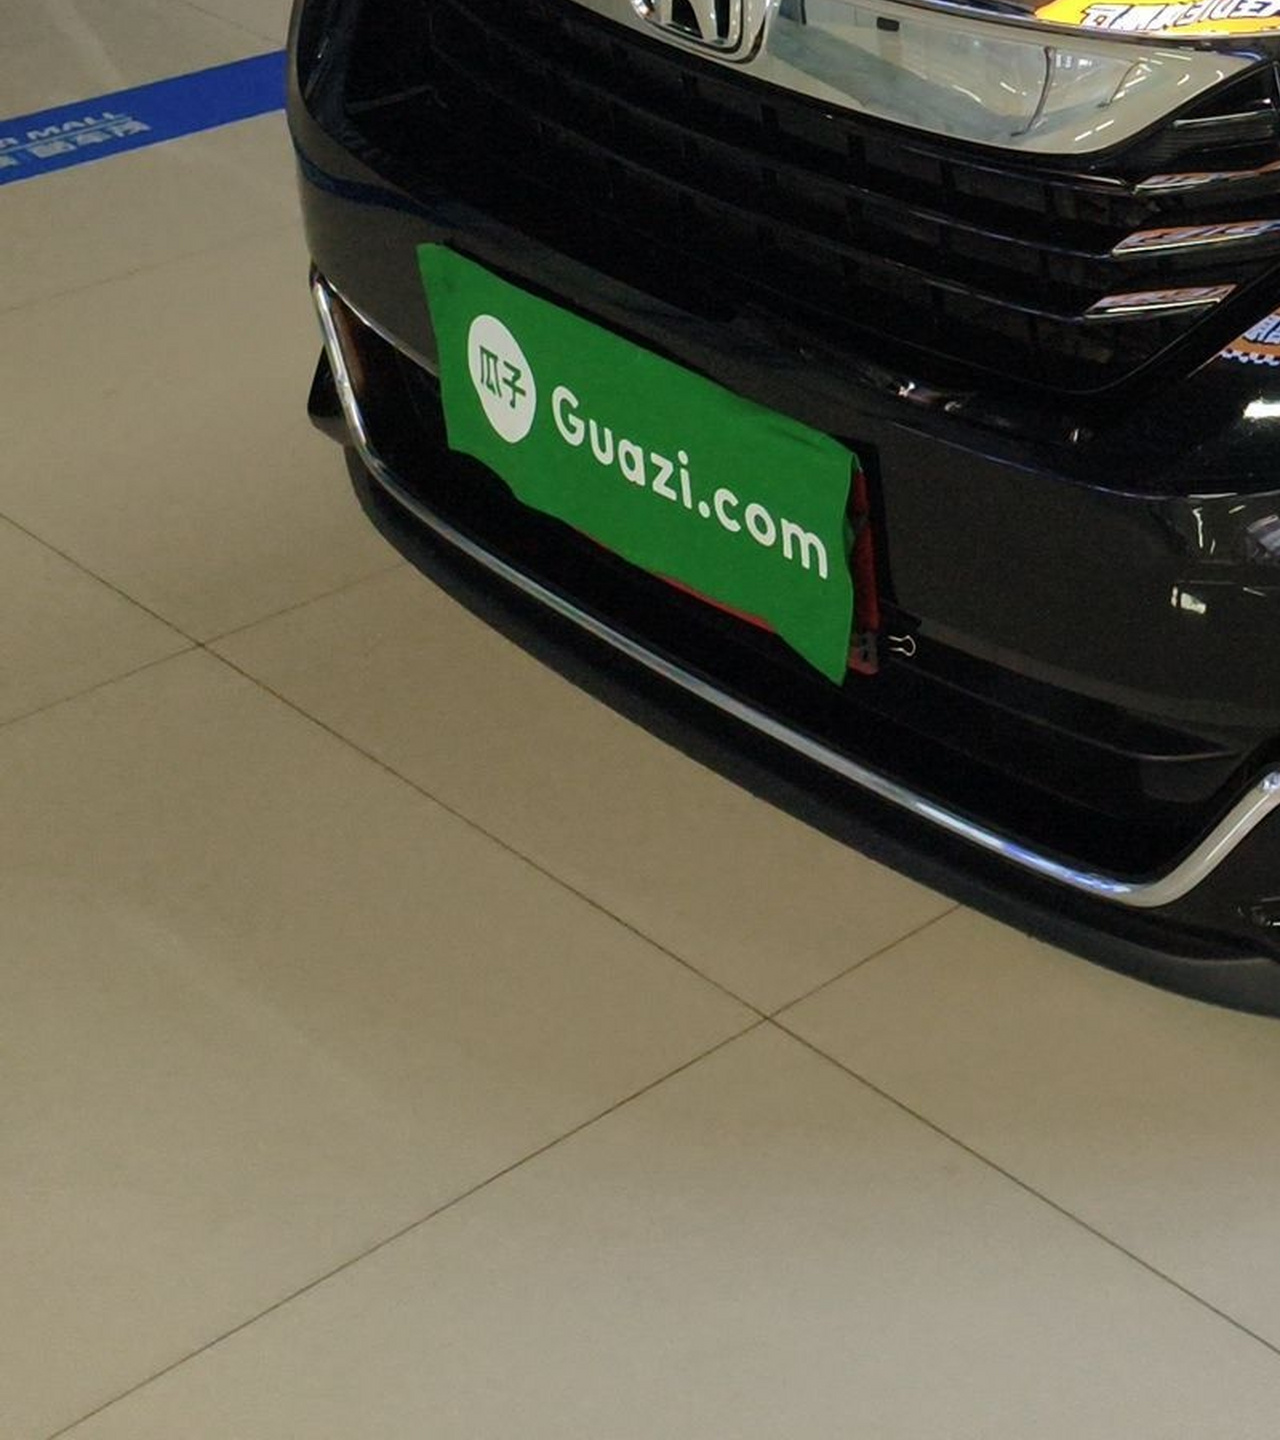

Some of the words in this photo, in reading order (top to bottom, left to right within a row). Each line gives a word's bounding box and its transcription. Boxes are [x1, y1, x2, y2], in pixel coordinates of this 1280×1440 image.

[26, 111, 126, 141] MALL
[478, 344, 527, 409] 瓜子
[550, 384, 829, 581] Guazi.com
